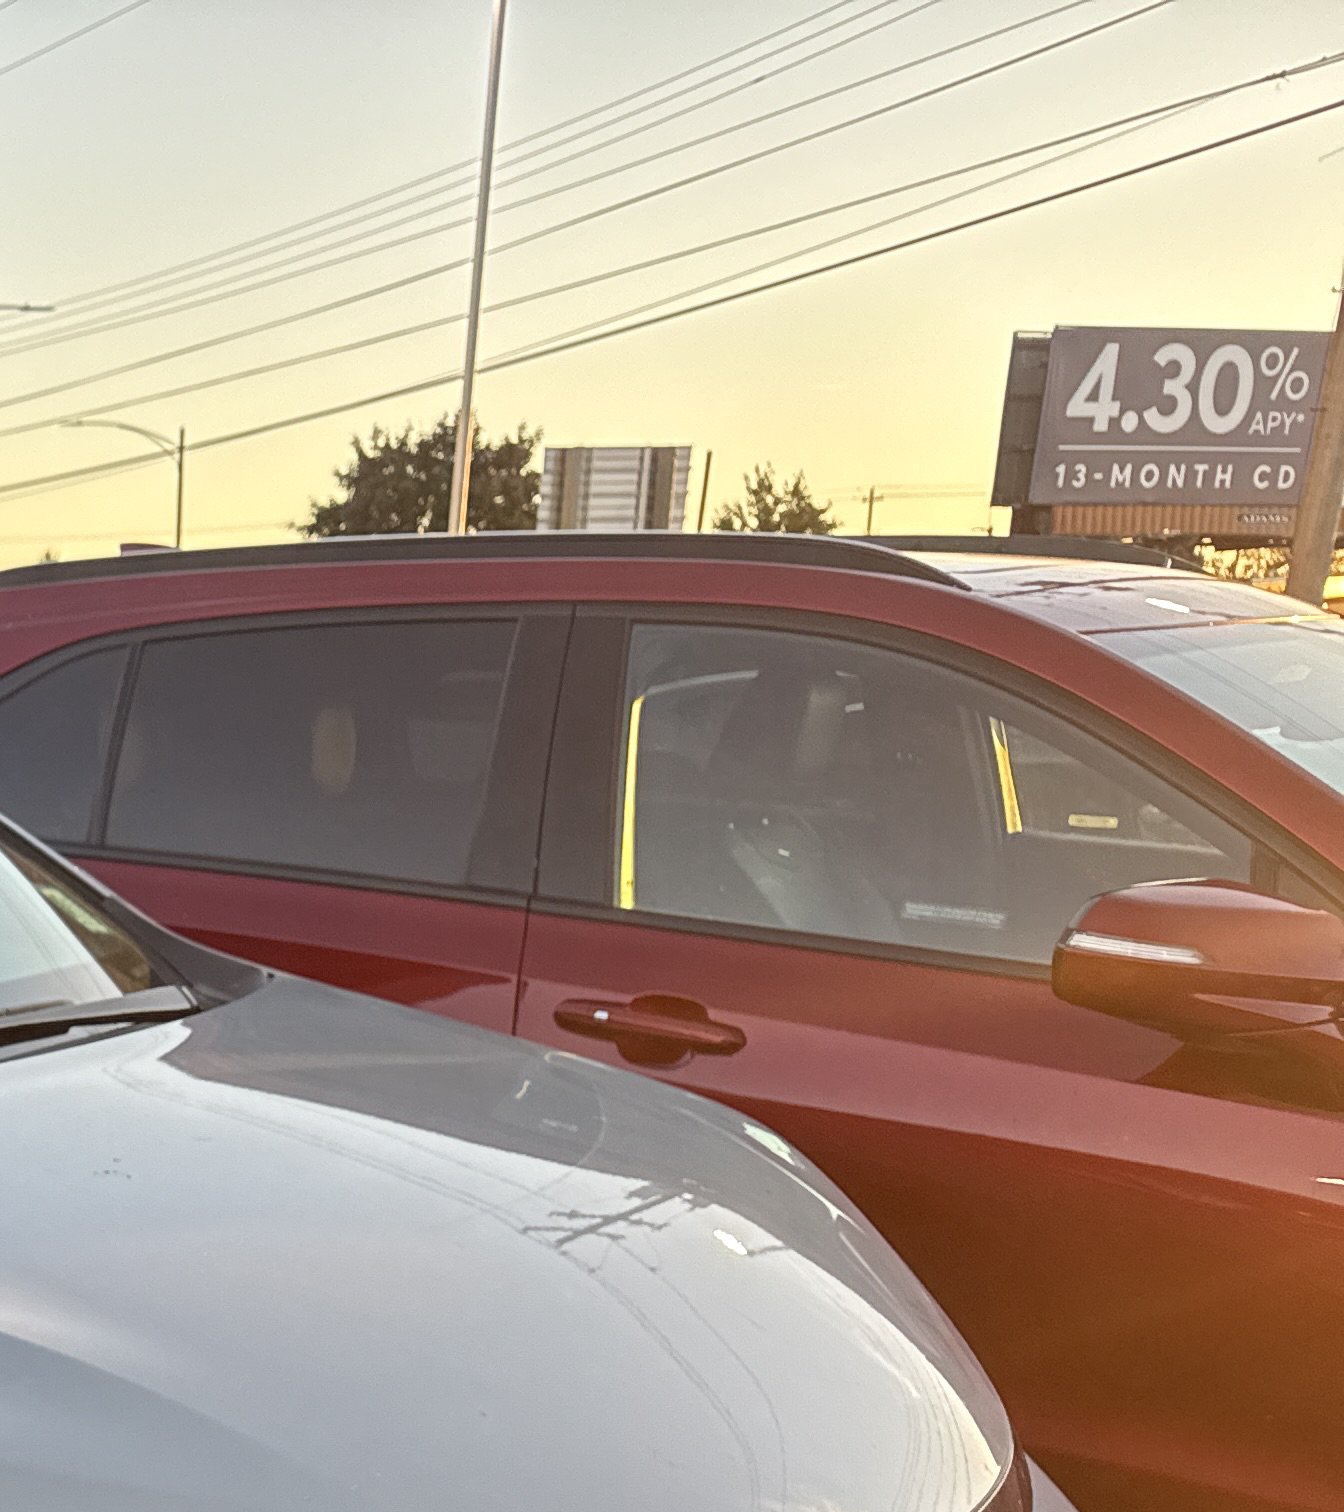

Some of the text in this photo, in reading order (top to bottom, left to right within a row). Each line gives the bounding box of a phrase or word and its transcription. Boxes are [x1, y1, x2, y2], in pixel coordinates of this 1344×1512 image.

[1065, 342, 1310, 434] 4.30%
[1055, 463, 1297, 489] 13-MONTH CD
